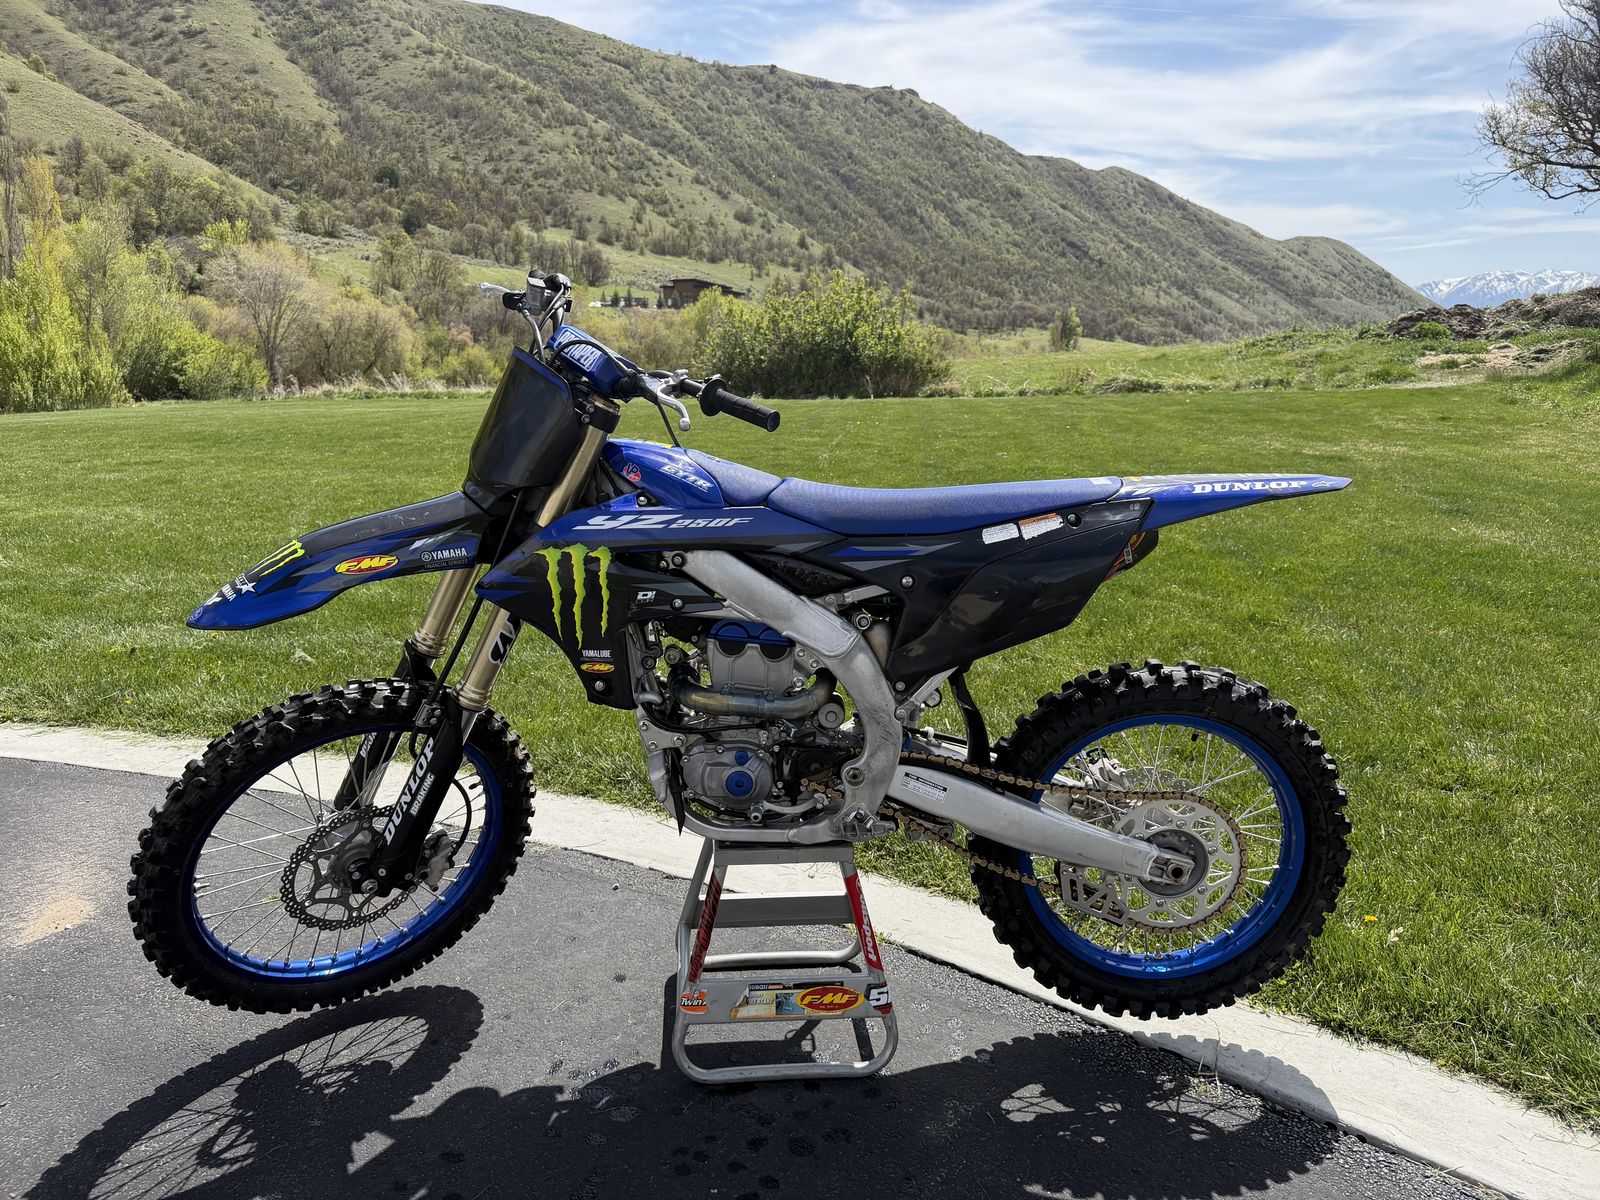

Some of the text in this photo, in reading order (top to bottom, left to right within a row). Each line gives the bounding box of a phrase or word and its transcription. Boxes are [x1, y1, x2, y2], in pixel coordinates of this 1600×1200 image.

[1192, 480, 1308, 494] DUNLOP
[431, 547, 468, 560] YAMAHA
[336, 555, 398, 573] FMF
[424, 561, 448, 569] FINANCIAL
[581, 649, 612, 658] YAMALUBE
[383, 736, 435, 846] DUNLOP
[409, 772, 435, 817] BRAKING
[800, 992, 857, 1005] FMF
